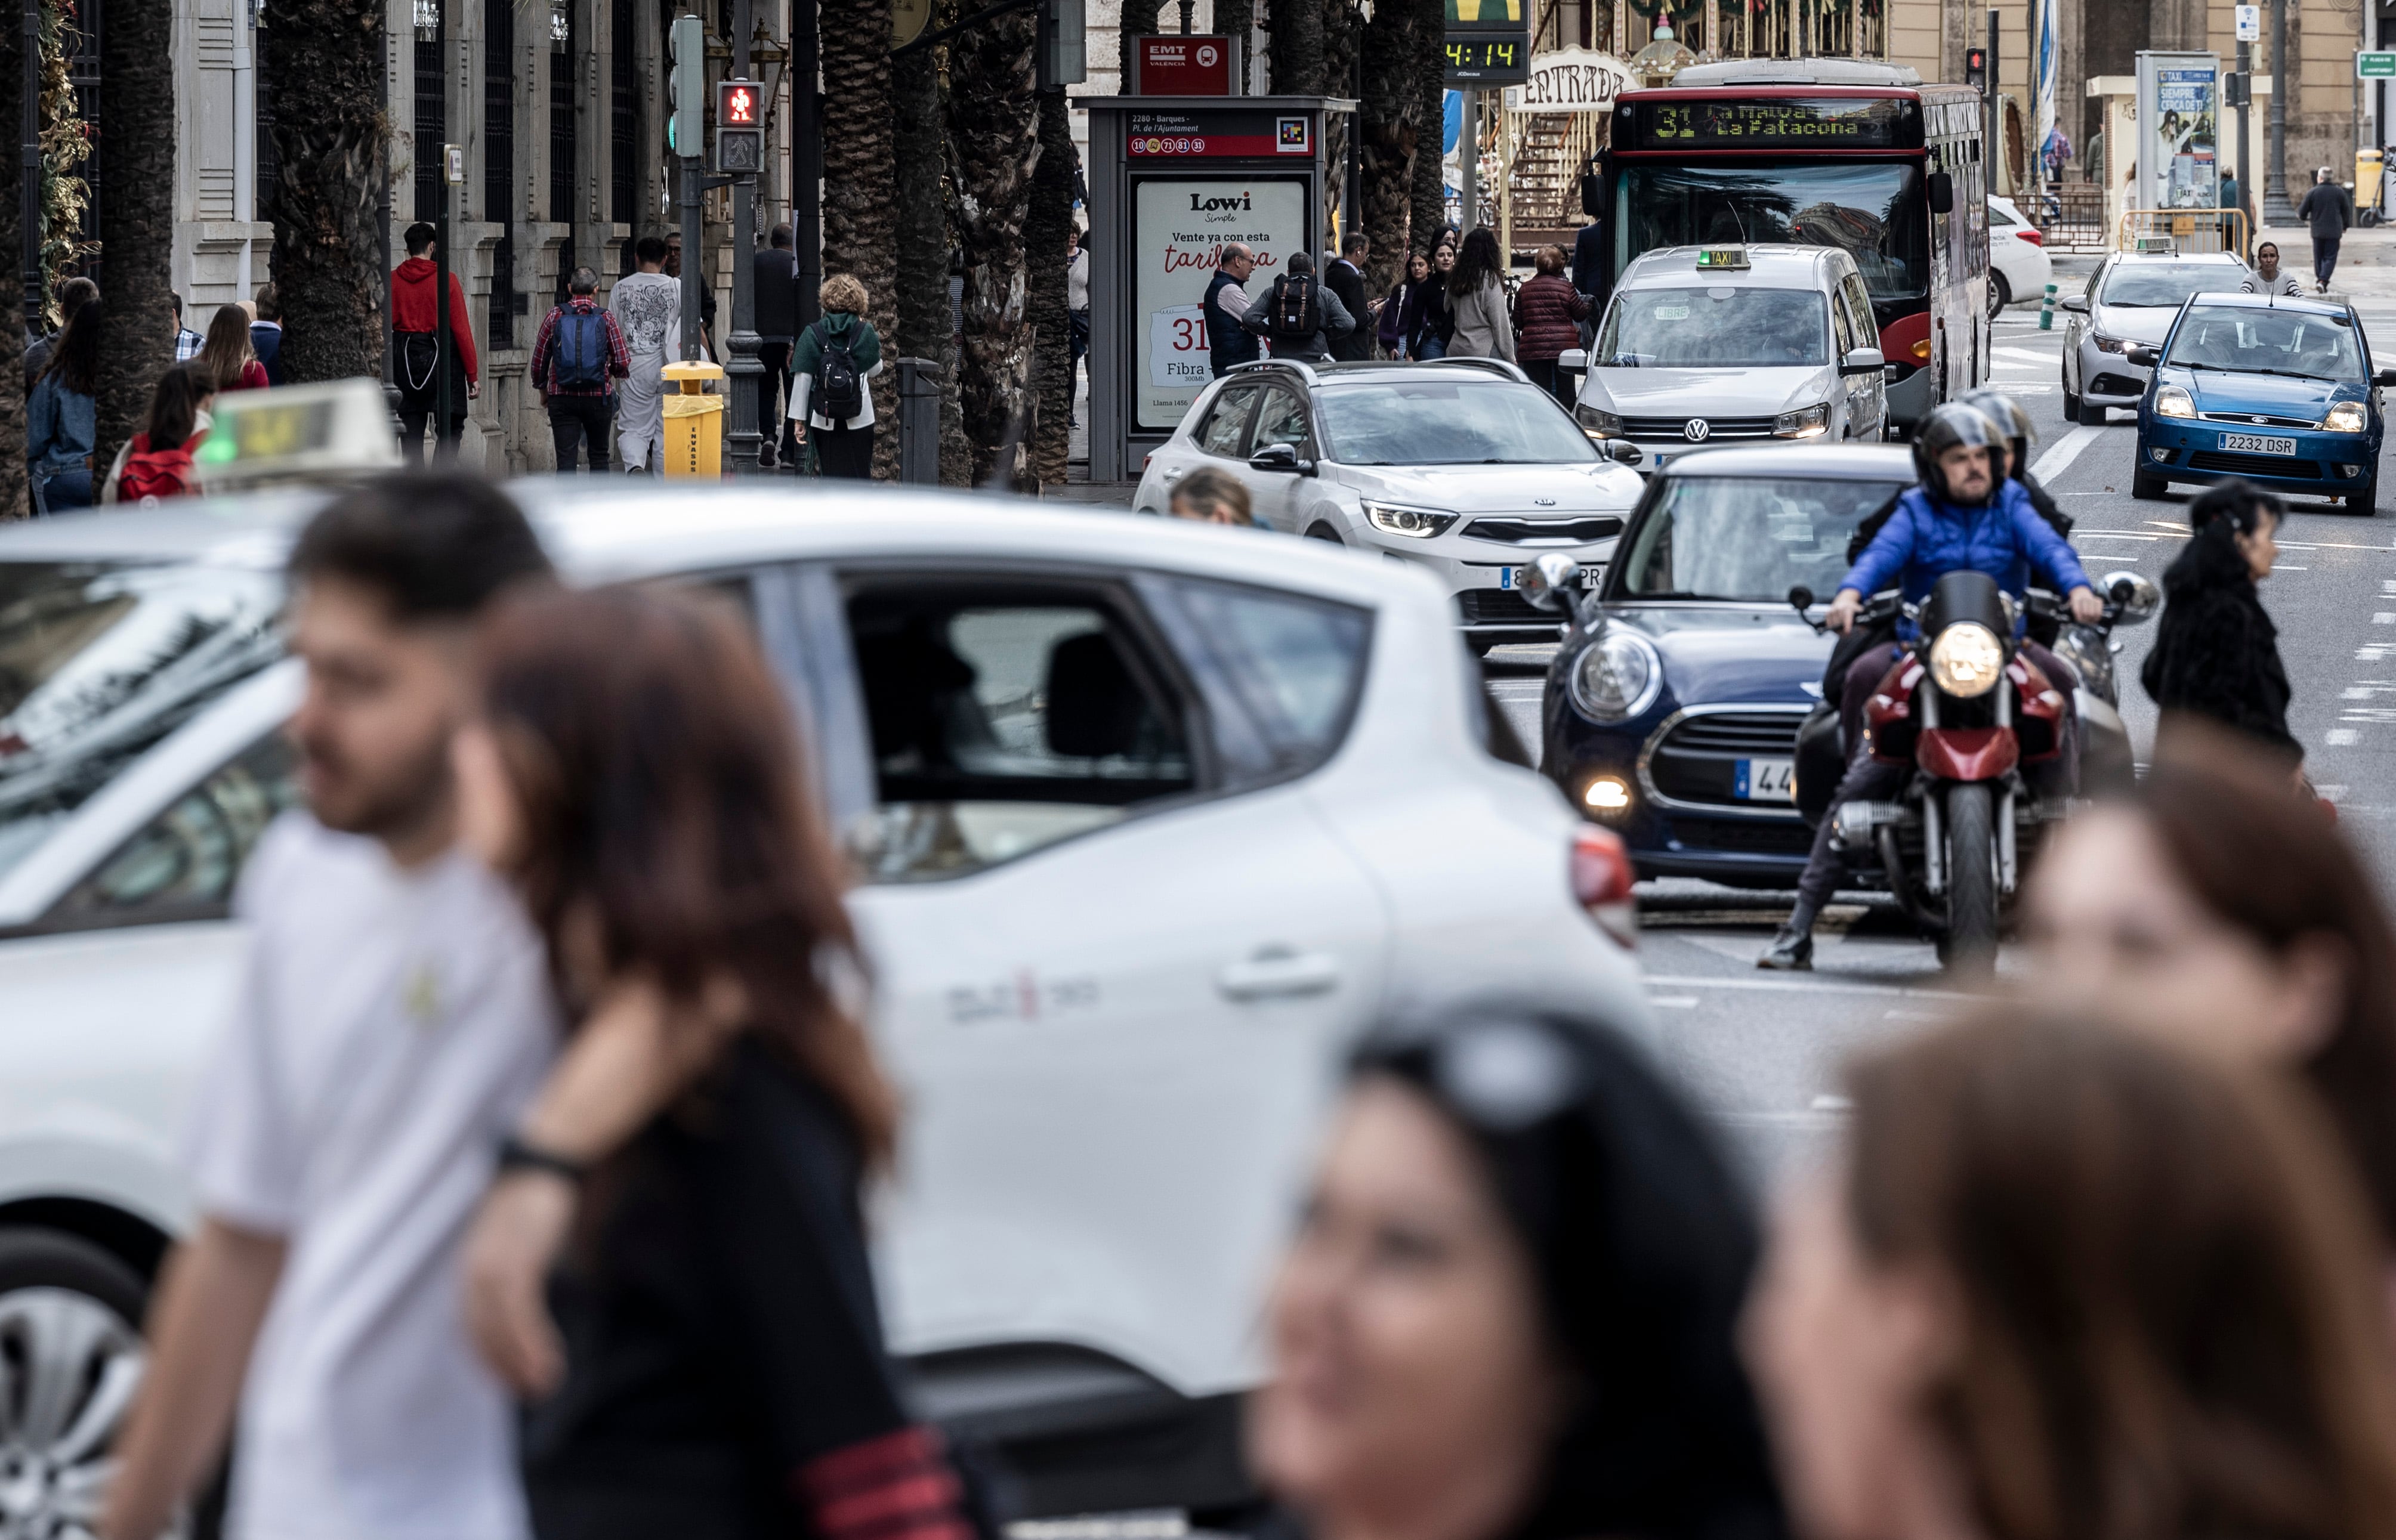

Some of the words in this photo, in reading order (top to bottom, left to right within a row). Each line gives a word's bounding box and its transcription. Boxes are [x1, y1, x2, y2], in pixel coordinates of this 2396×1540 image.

[1446, 44, 1513, 67] 4:14
[2167, 72, 2183, 81] TAXI
[1524, 64, 1624, 104] ENTRADA
[2161, 88, 2194, 99] SIEMPRE
[2161, 100, 2184, 110] CERCA
[2185, 100, 2195, 110] DE
[1157, 115, 1185, 123] Barques
[1656, 105, 1694, 137] 31
[1154, 124, 1199, 133] l'Ajuntament
[1718, 120, 1742, 135] La
[1190, 191, 1251, 211] Lowi
[1205, 213, 1236, 223] Simple
[1172, 232, 1205, 242] Vente
[1208, 234, 1221, 244] ya
[1246, 232, 1270, 242] esta
[2147, 239, 2163, 249] TAXI
[1711, 251, 1731, 263] TAXI
[1658, 308, 1686, 318] LIBRE
[1167, 363, 1204, 375] Fibra
[2229, 436, 2262, 450] 2232
[2267, 439, 2292, 453] DSR
[1581, 568, 1600, 586] PR
[1759, 766, 1791, 793] 44
